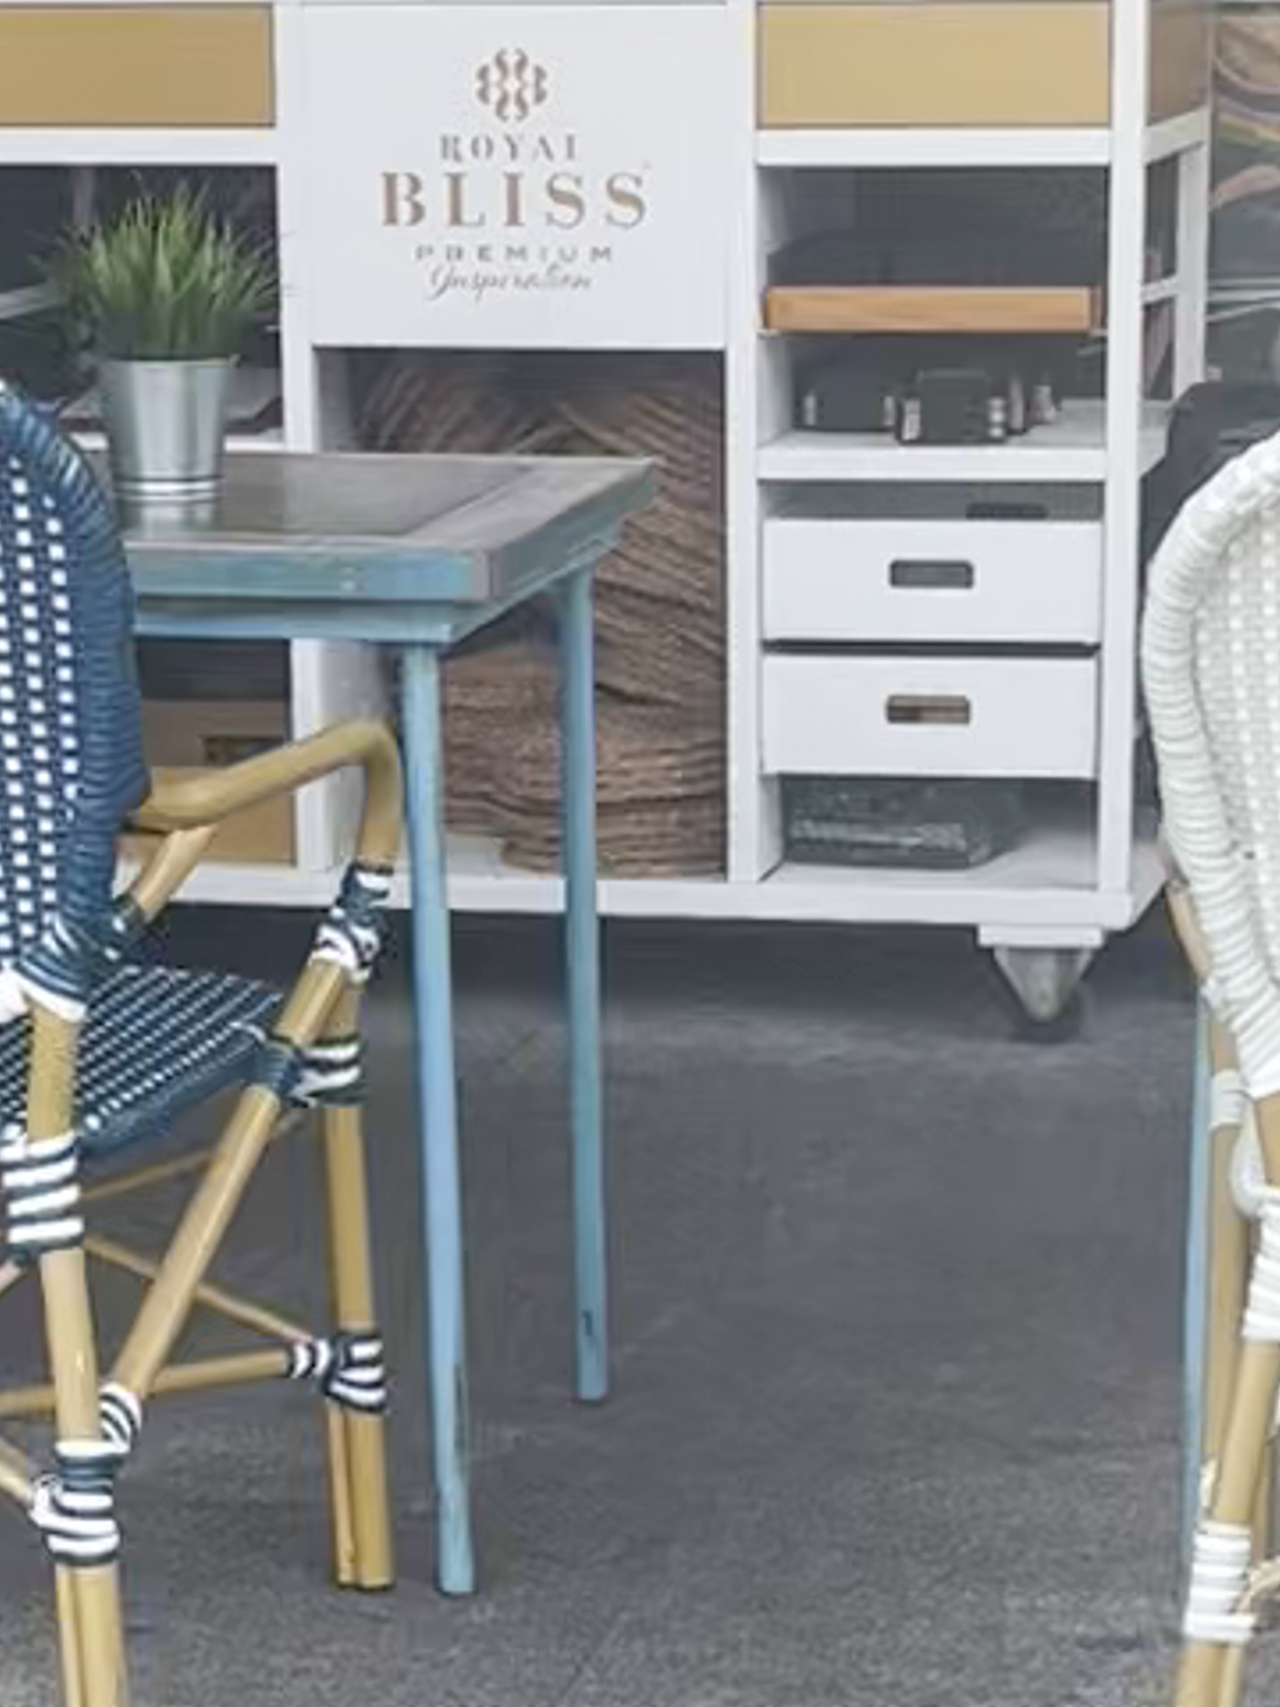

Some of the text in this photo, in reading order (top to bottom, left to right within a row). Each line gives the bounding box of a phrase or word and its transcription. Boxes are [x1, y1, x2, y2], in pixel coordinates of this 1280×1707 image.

[439, 133, 578, 162] ROYAL
[380, 171, 646, 231] BLISS
[414, 244, 612, 262] PREMIUM
